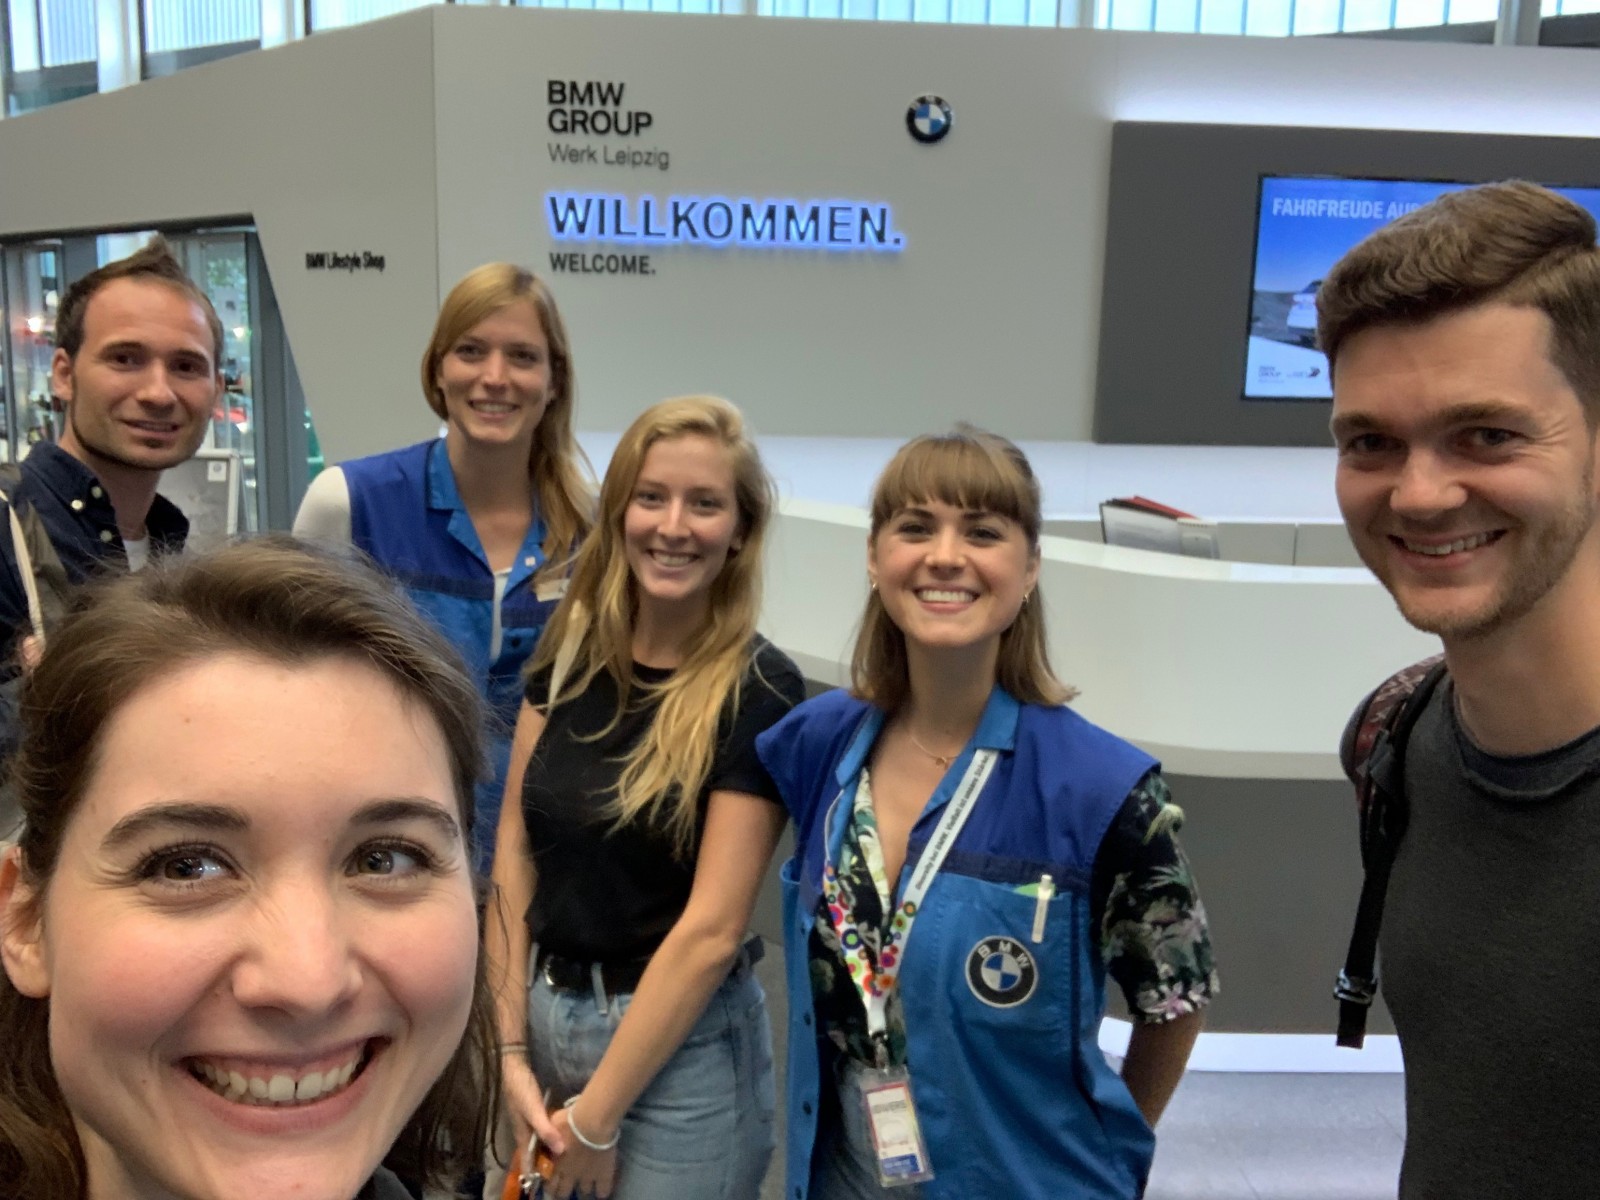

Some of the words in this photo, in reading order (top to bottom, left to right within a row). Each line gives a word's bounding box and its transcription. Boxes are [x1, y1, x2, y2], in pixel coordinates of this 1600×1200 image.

[548, 80, 625, 107] BMW
[548, 108, 653, 136] GROUP
[547, 142, 598, 164] Werk
[603, 144, 669, 171] Leipzig
[549, 196, 901, 245] WILLKOMMEN.
[1272, 198, 1383, 219] FAHRFREUDE
[550, 253, 656, 275] WELCOME.
[978, 940, 1030, 969] BMW
